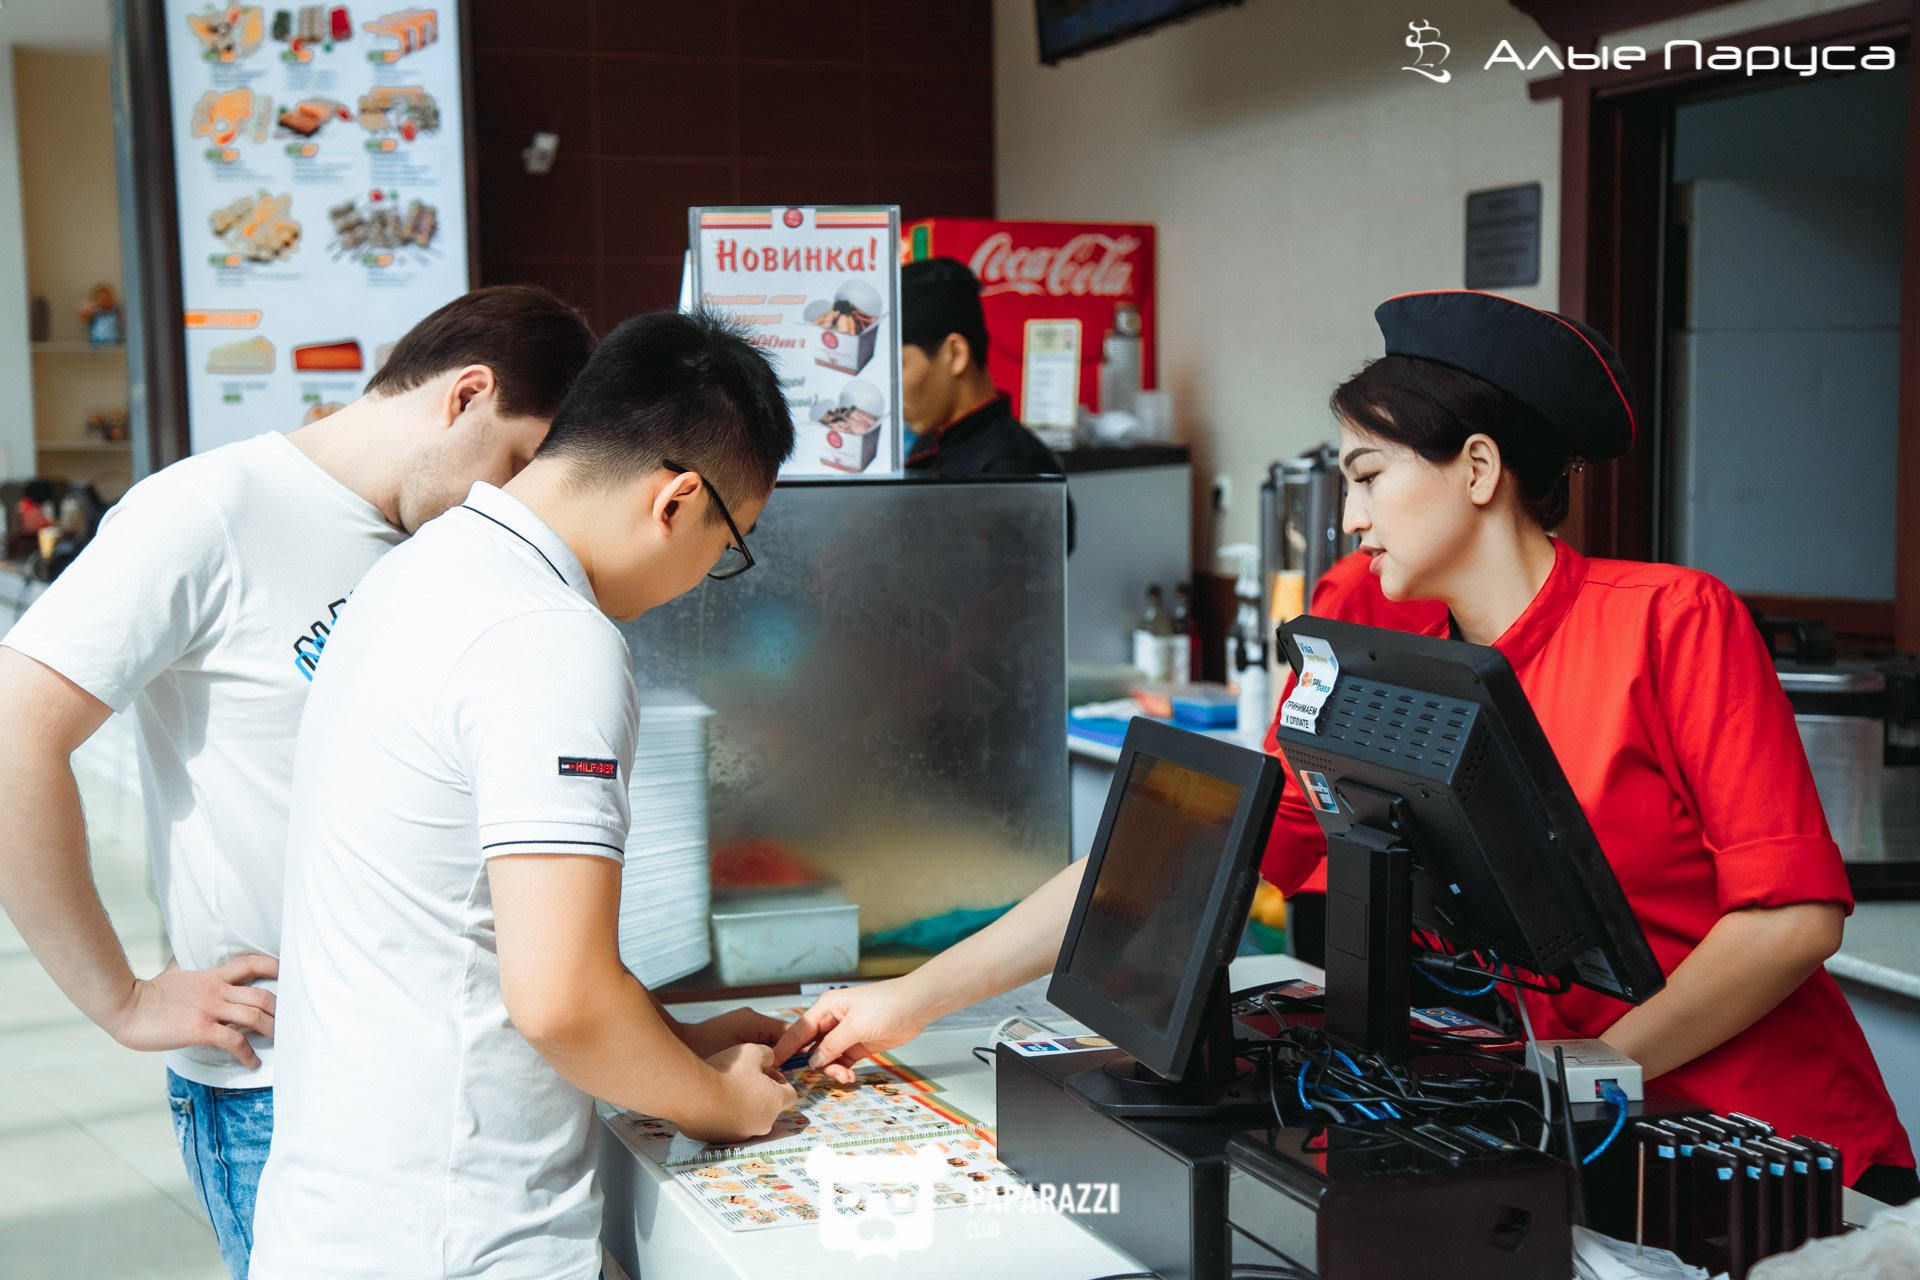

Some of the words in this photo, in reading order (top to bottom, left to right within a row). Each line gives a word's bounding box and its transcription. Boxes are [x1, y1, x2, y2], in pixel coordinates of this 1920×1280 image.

[716, 236, 878, 272] Новинка!
[1284, 700, 1318, 716] ПРИНИМАЕМ
[1290, 715, 1310, 730] ОПЛАТЕ
[575, 762, 614, 774] HILFIGER
